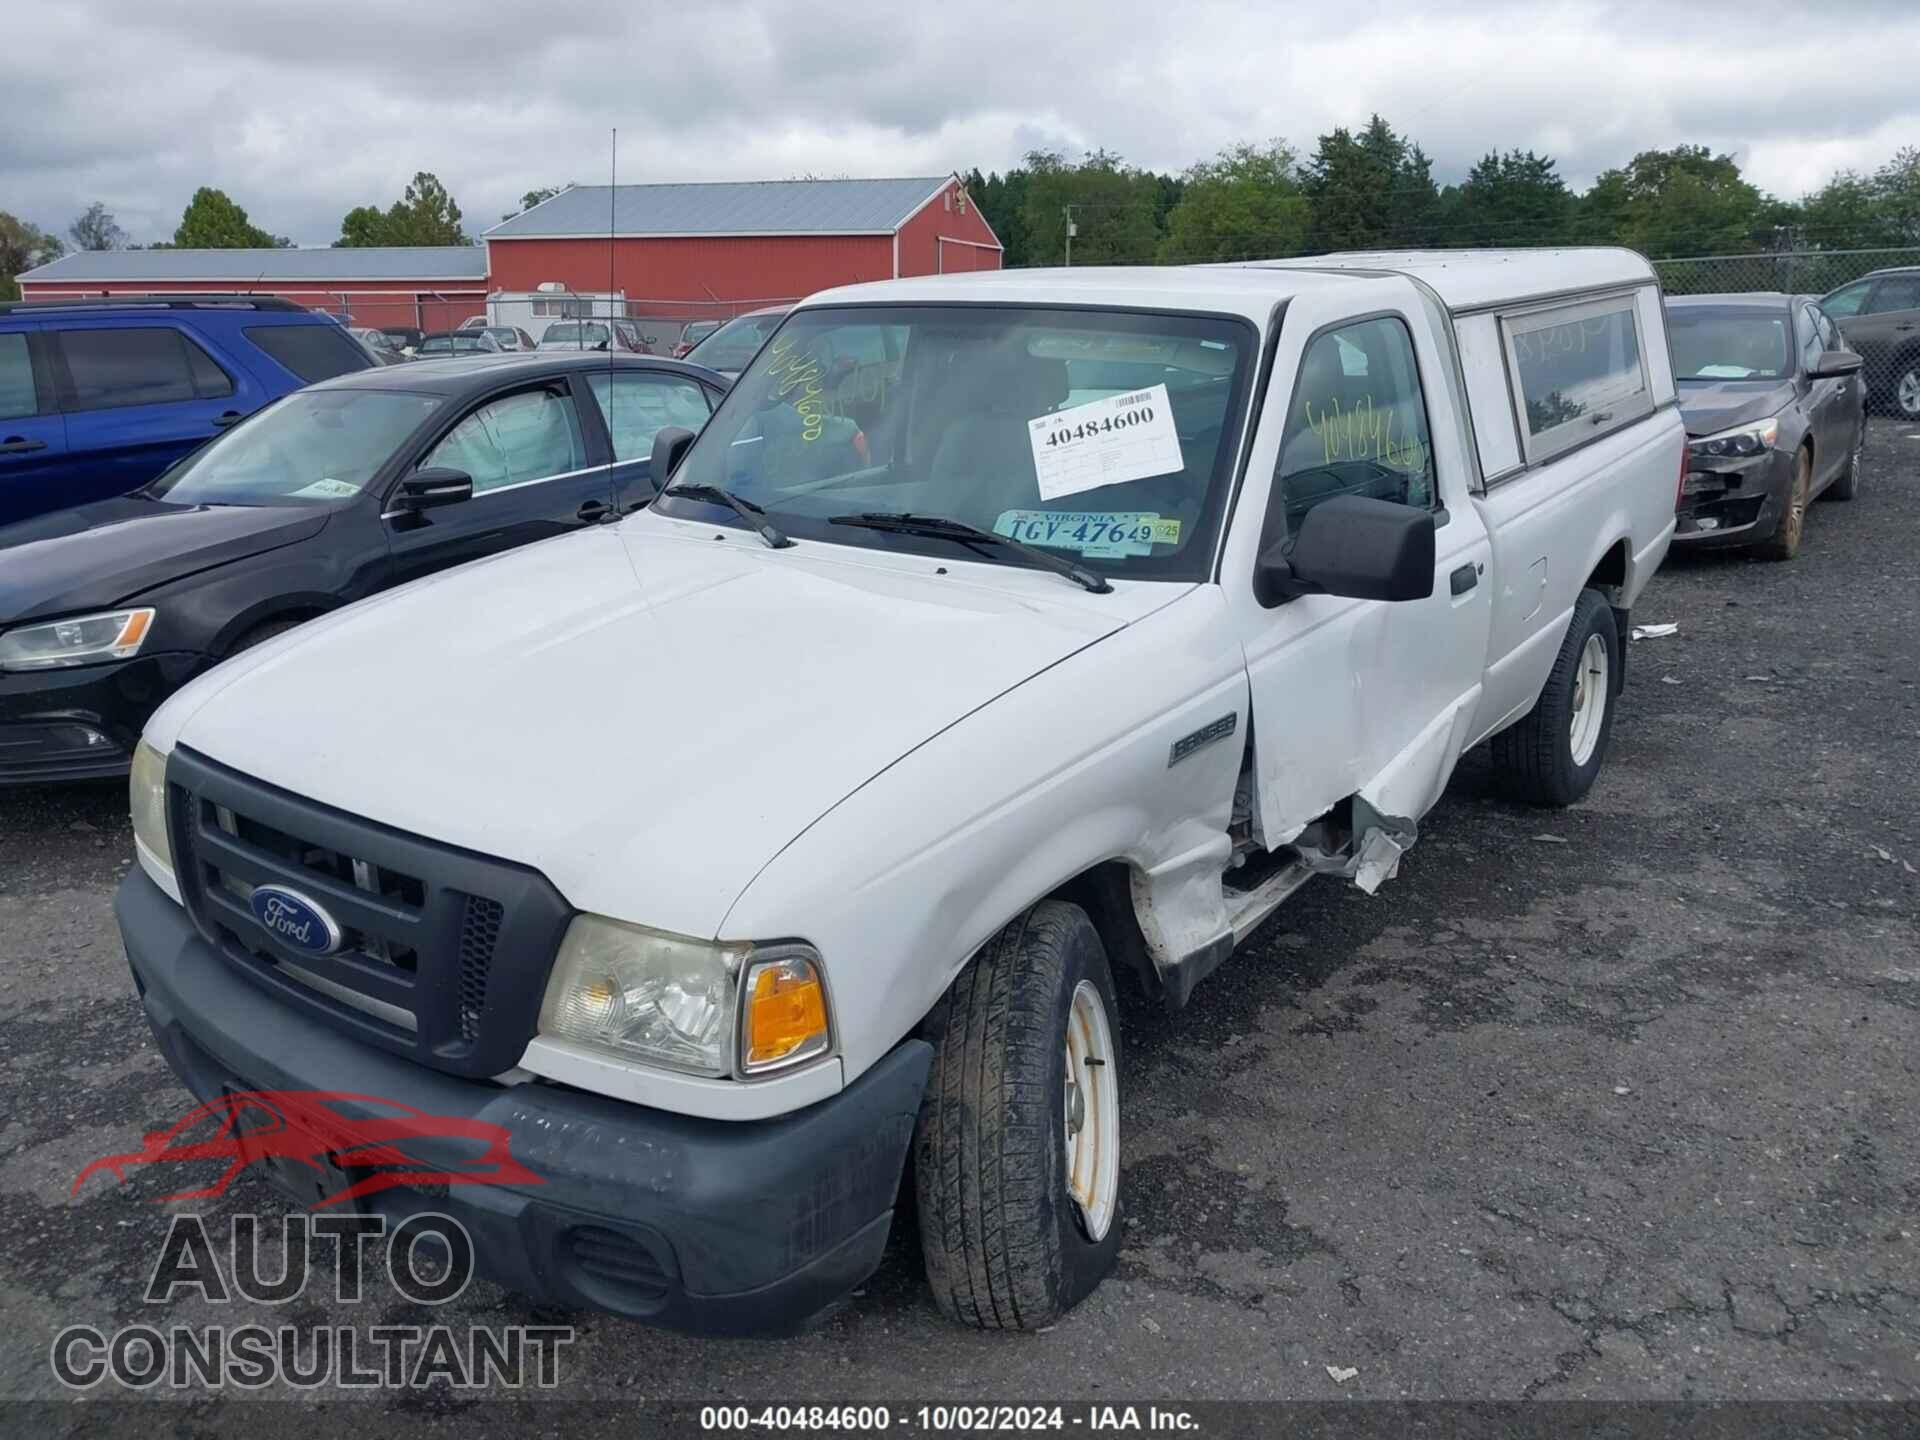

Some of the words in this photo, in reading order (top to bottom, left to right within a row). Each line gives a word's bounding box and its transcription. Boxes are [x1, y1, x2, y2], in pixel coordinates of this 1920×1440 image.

[1045, 406, 1155, 448] 40484600
[1044, 513, 1116, 523] VIRGINIA
[263, 897, 311, 943] Ford
